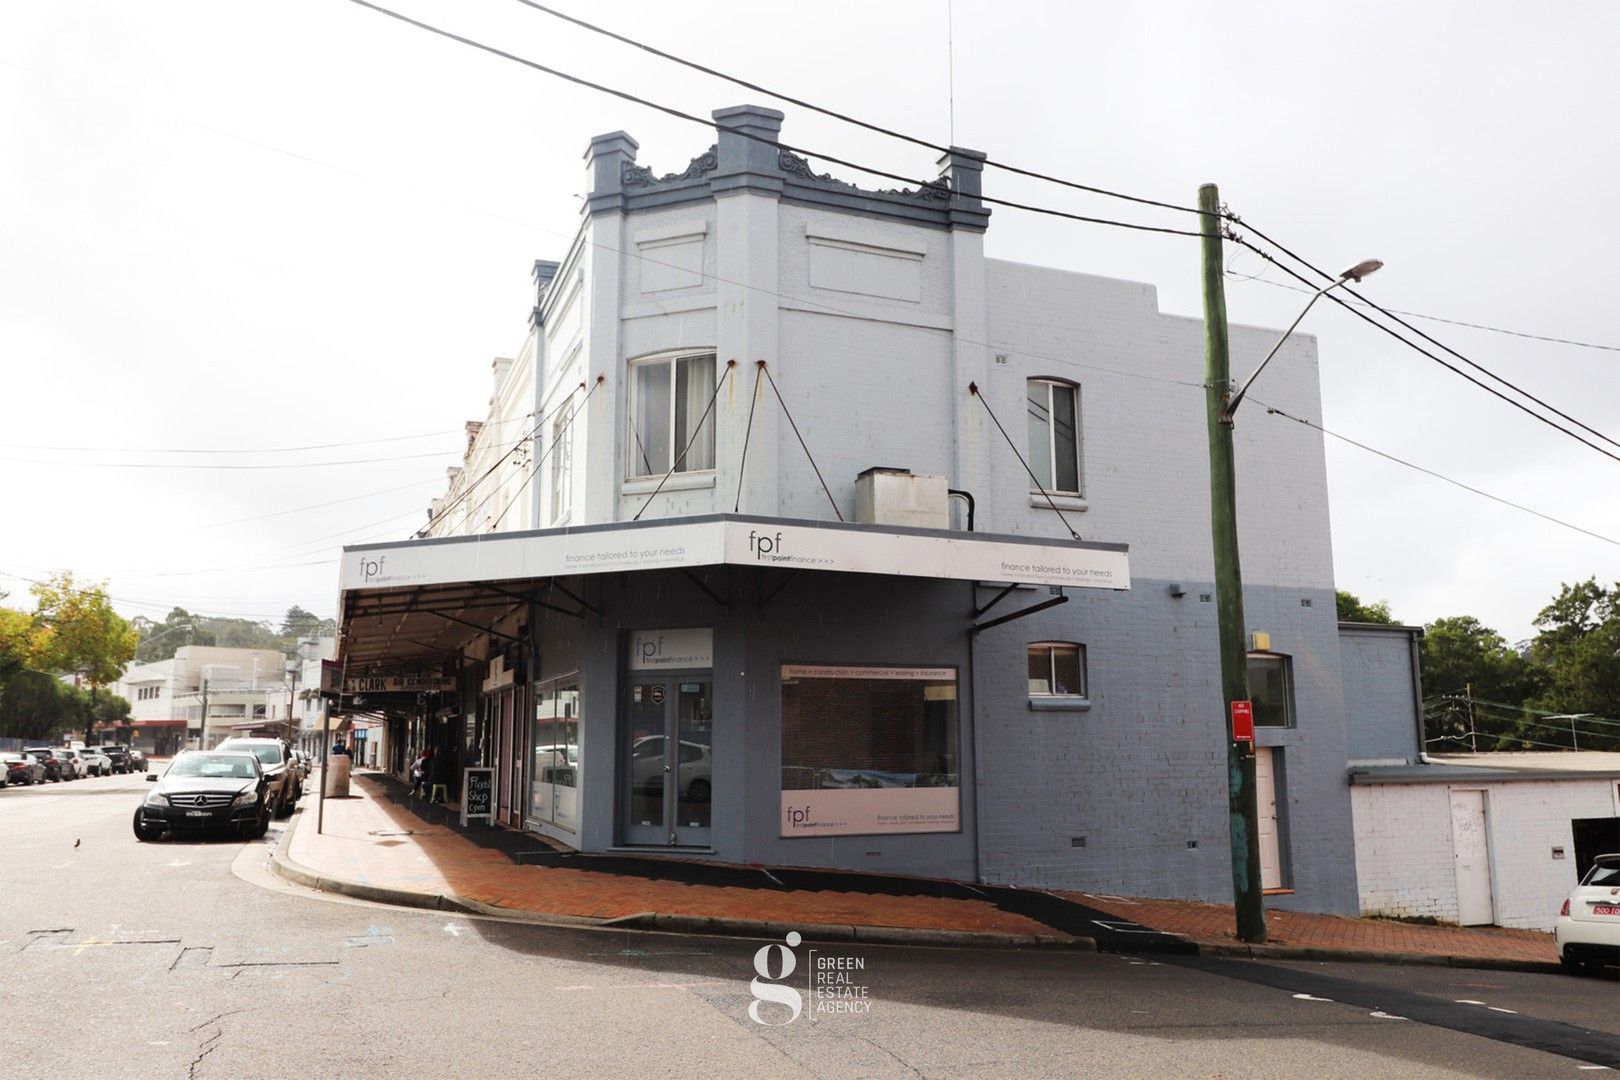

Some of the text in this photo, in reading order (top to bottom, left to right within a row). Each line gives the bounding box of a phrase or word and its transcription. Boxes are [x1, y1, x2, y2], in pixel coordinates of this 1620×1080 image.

[566, 547, 685, 562] finance tailored to your needs
[749, 530, 782, 560] fpf
[360, 555, 385, 584] fpf
[1001, 562, 1030, 572] finance
[1032, 564, 1060, 574] tailored
[1063, 566, 1071, 575] to
[1072, 568, 1088, 577] your
[1090, 568, 1113, 578] needs
[636, 636, 664, 664] fpf
[359, 679, 386, 691] CLARK
[787, 806, 810, 828] fpf
